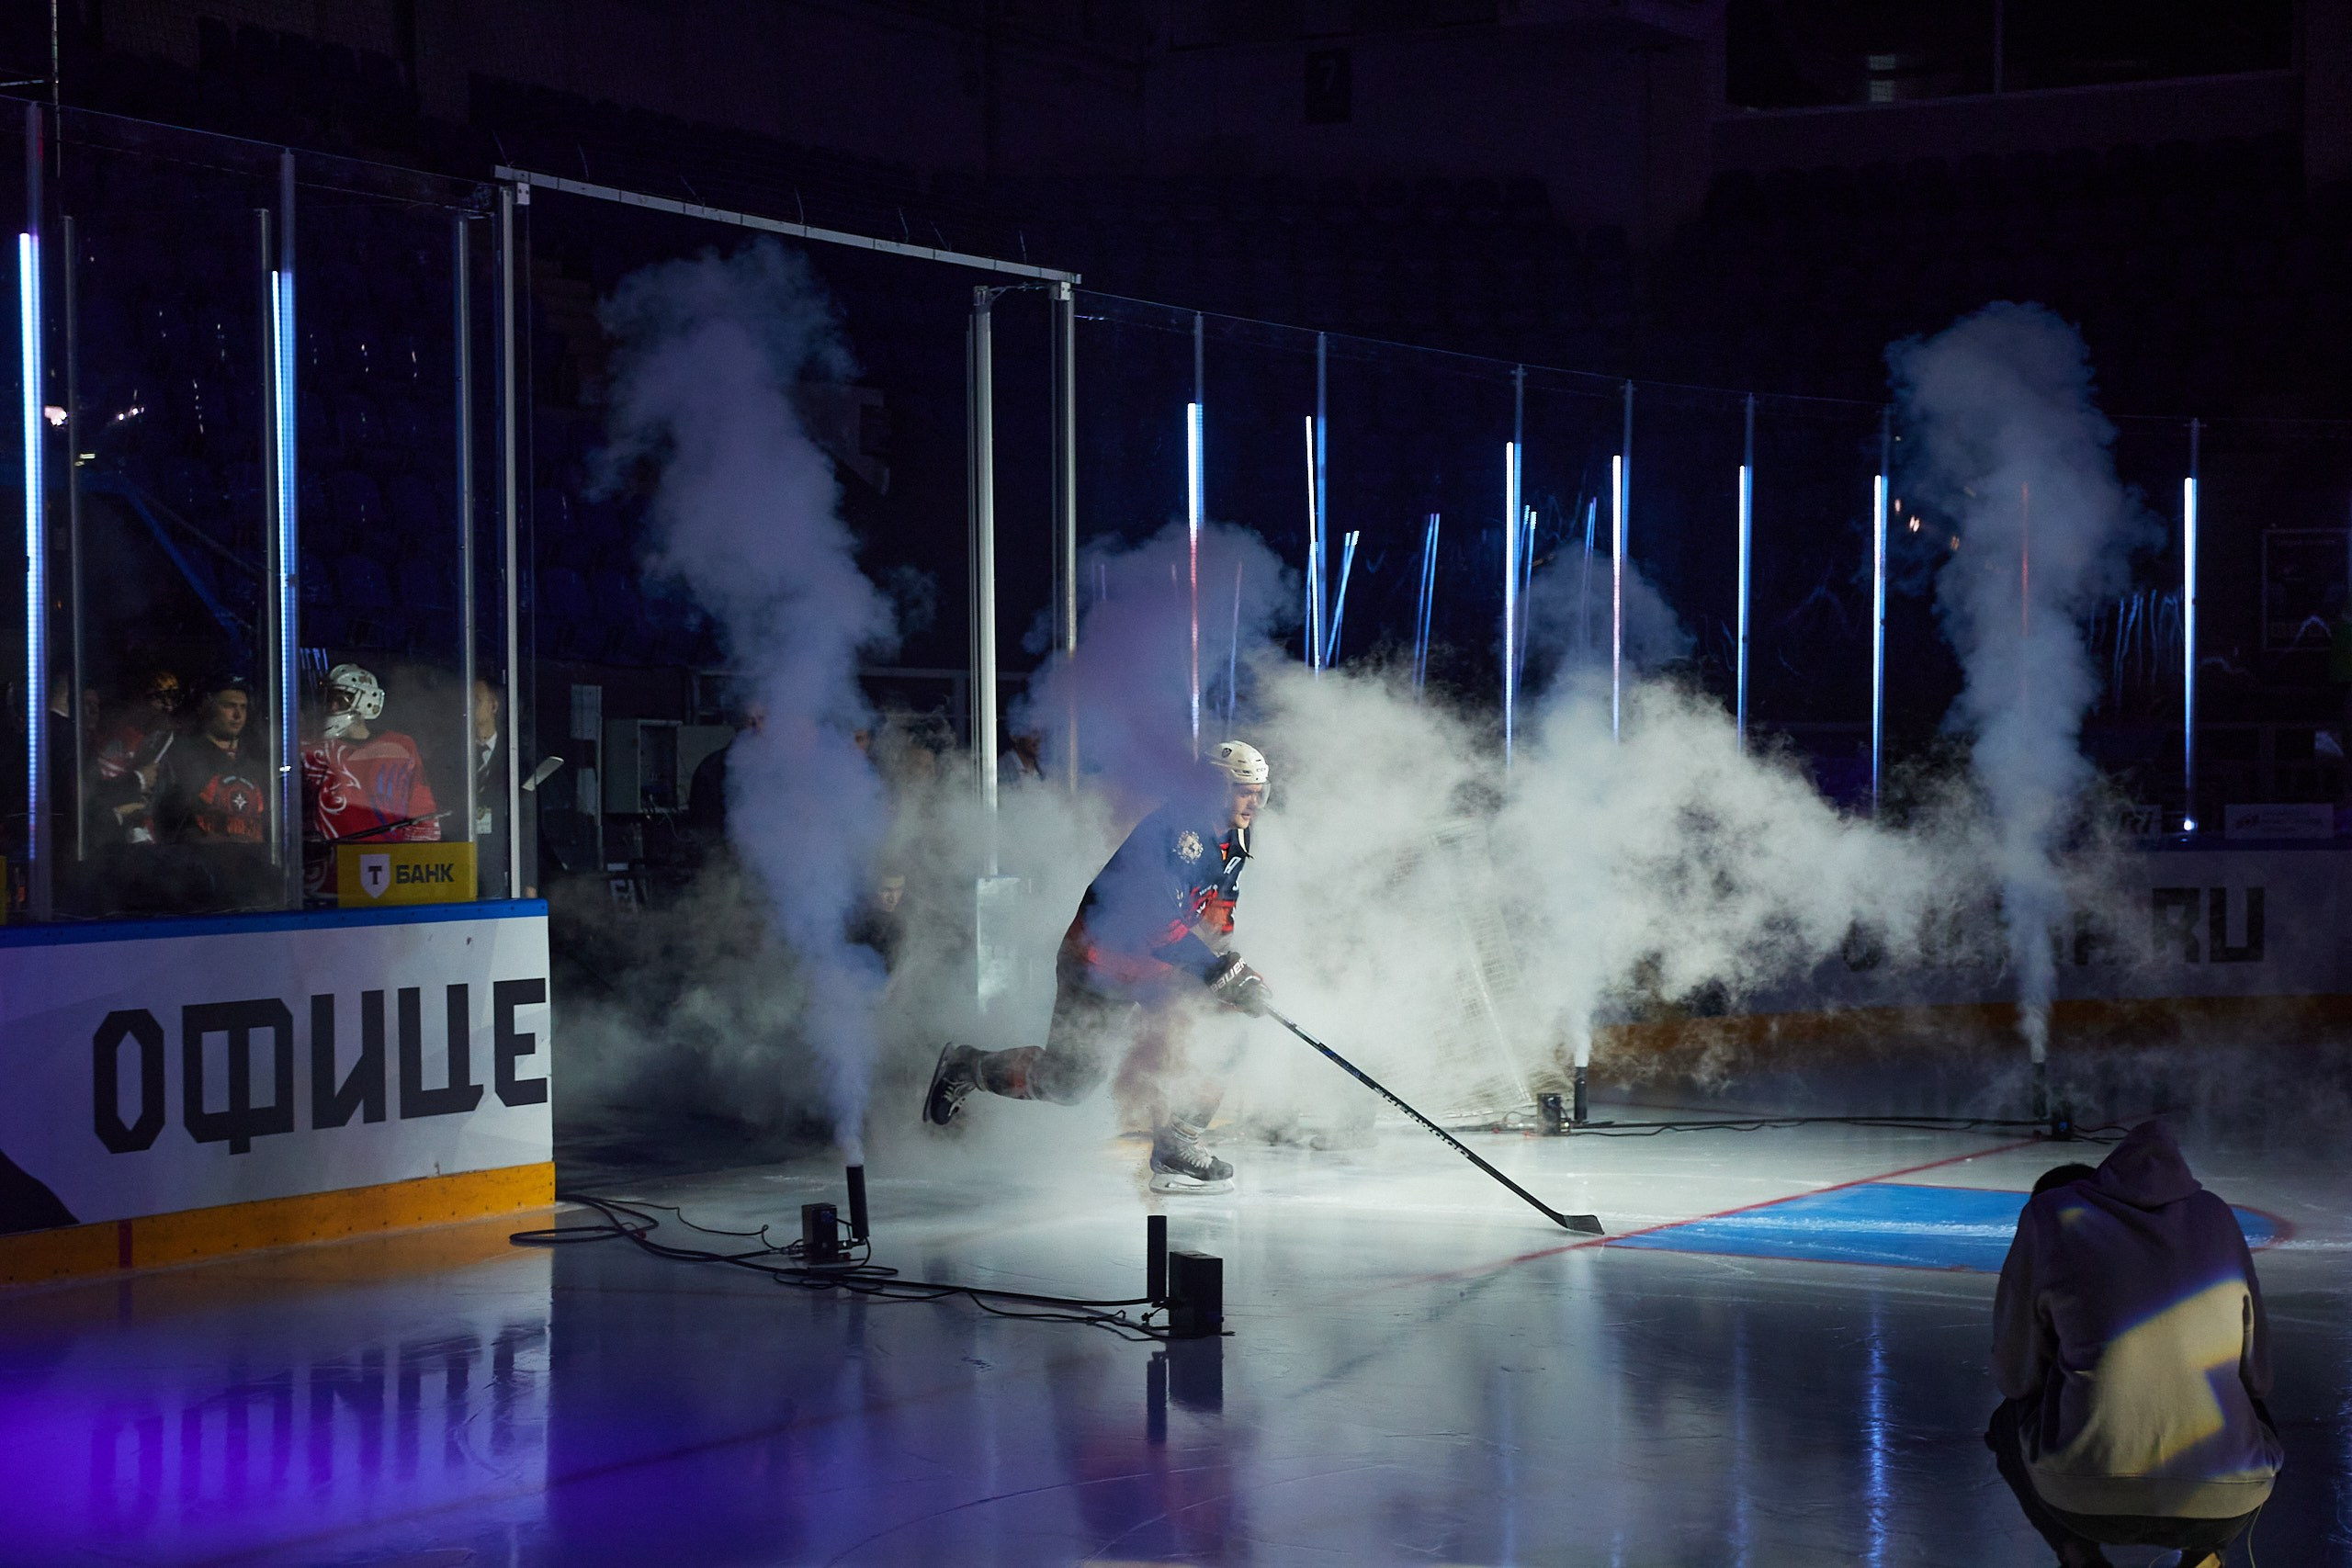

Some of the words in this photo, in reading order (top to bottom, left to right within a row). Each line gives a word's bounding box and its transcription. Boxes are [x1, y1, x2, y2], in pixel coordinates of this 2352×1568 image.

[396, 863, 455, 884] БАНК
[1210, 957, 1247, 993] BAUER
[93, 977, 548, 1156] ОФИЦЕ
